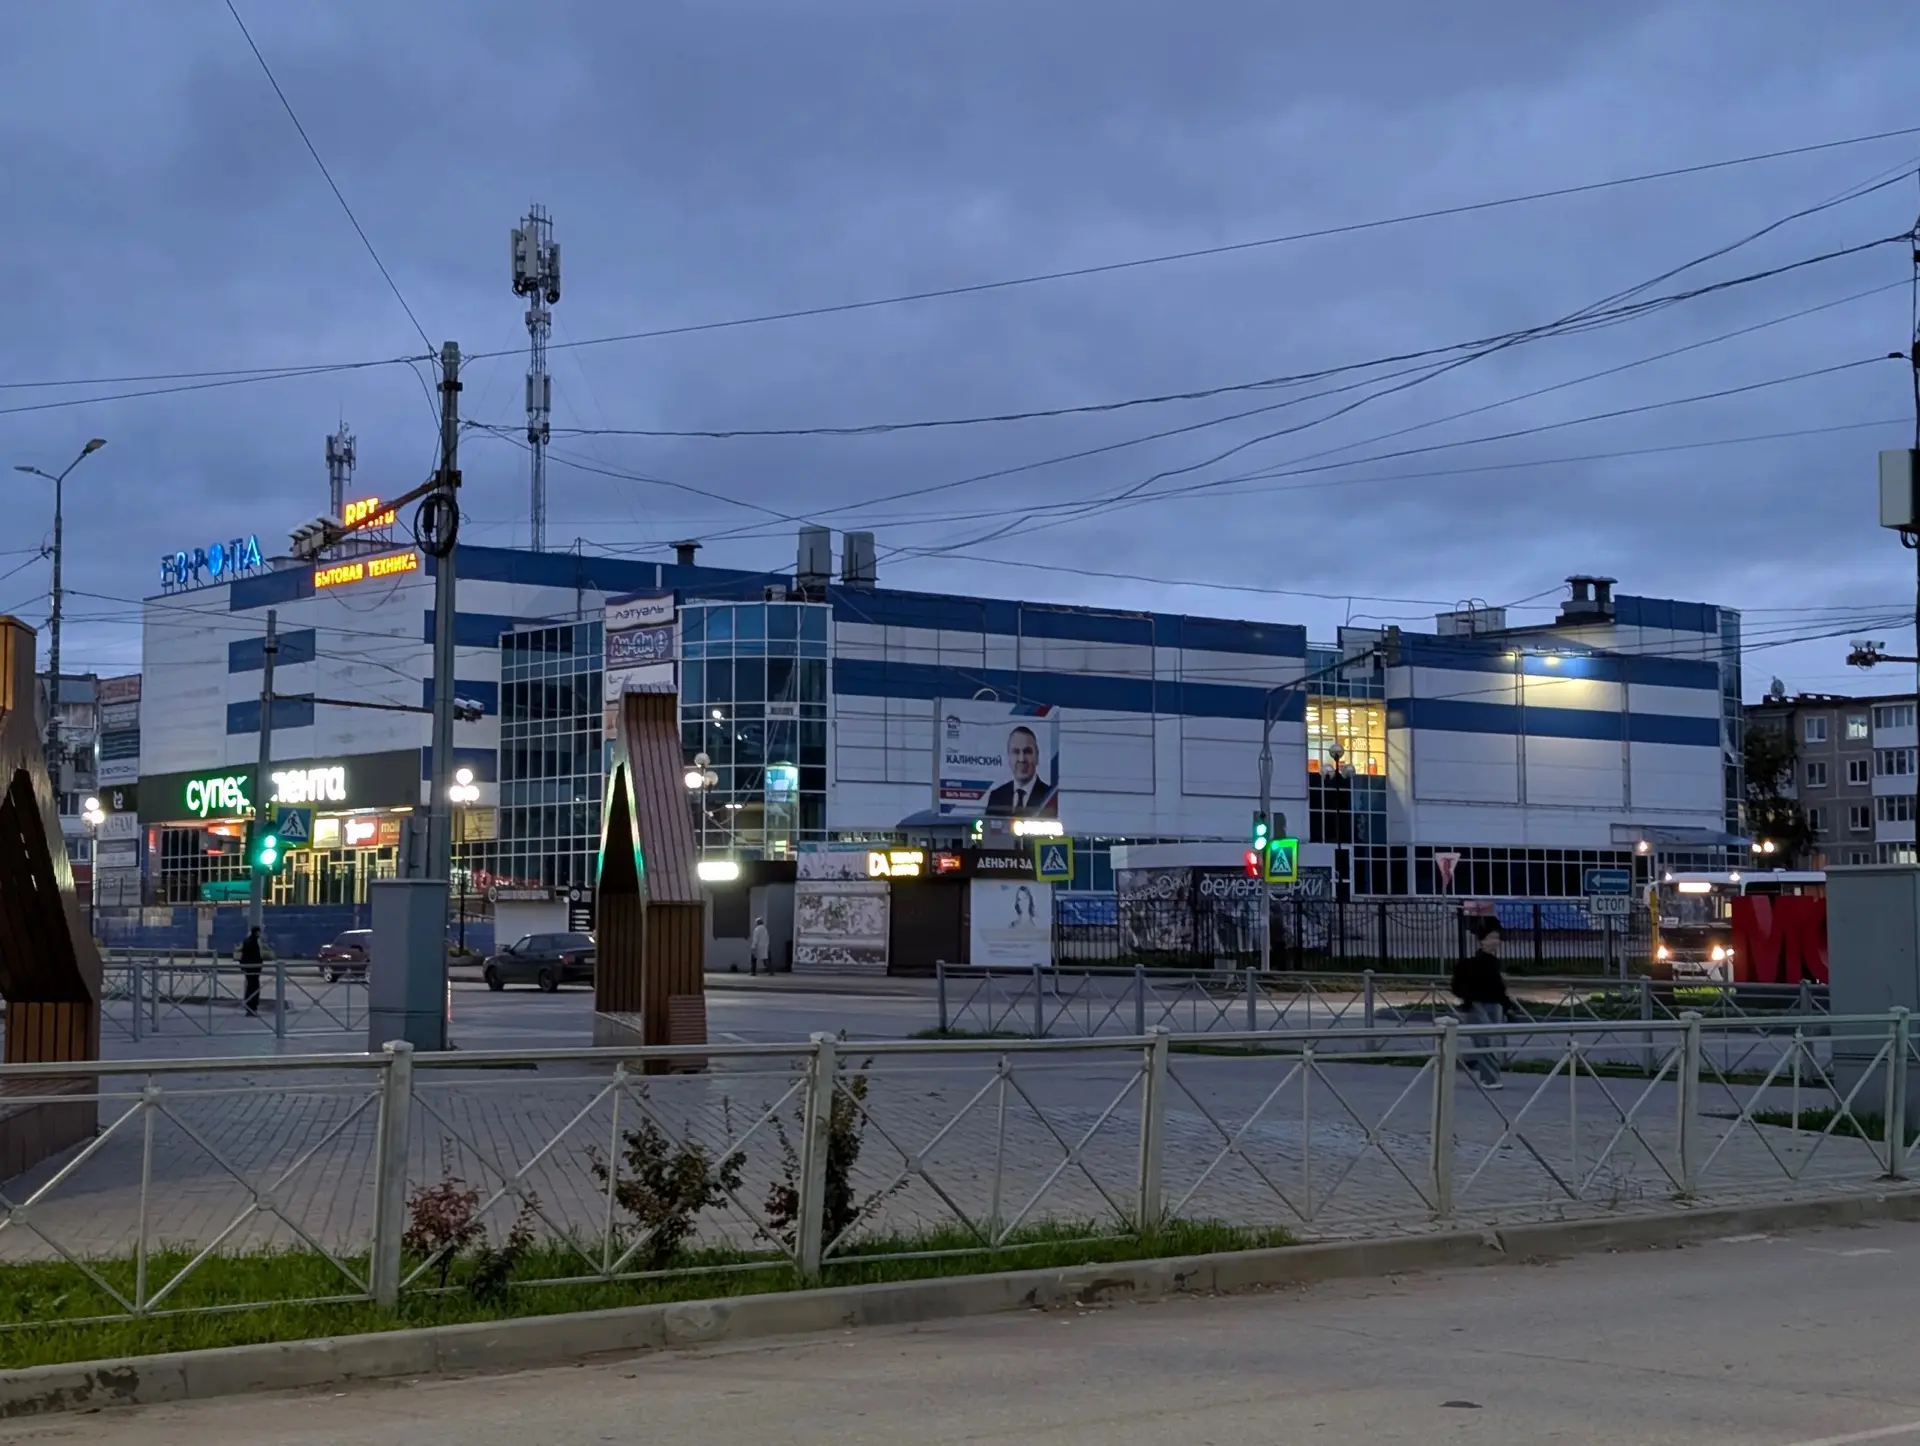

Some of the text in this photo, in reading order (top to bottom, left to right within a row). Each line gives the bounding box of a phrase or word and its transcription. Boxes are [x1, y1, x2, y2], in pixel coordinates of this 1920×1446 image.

[160, 533, 262, 589] ЕВРОПА
[314, 552, 418, 589] БЫТОВАЯ ТЕХНИКА
[946, 754, 1003, 767] КАЛИНСКИЙ
[977, 857, 1018, 869] ДЕНЬГИ
[1597, 899, 1625, 913] СТОП
